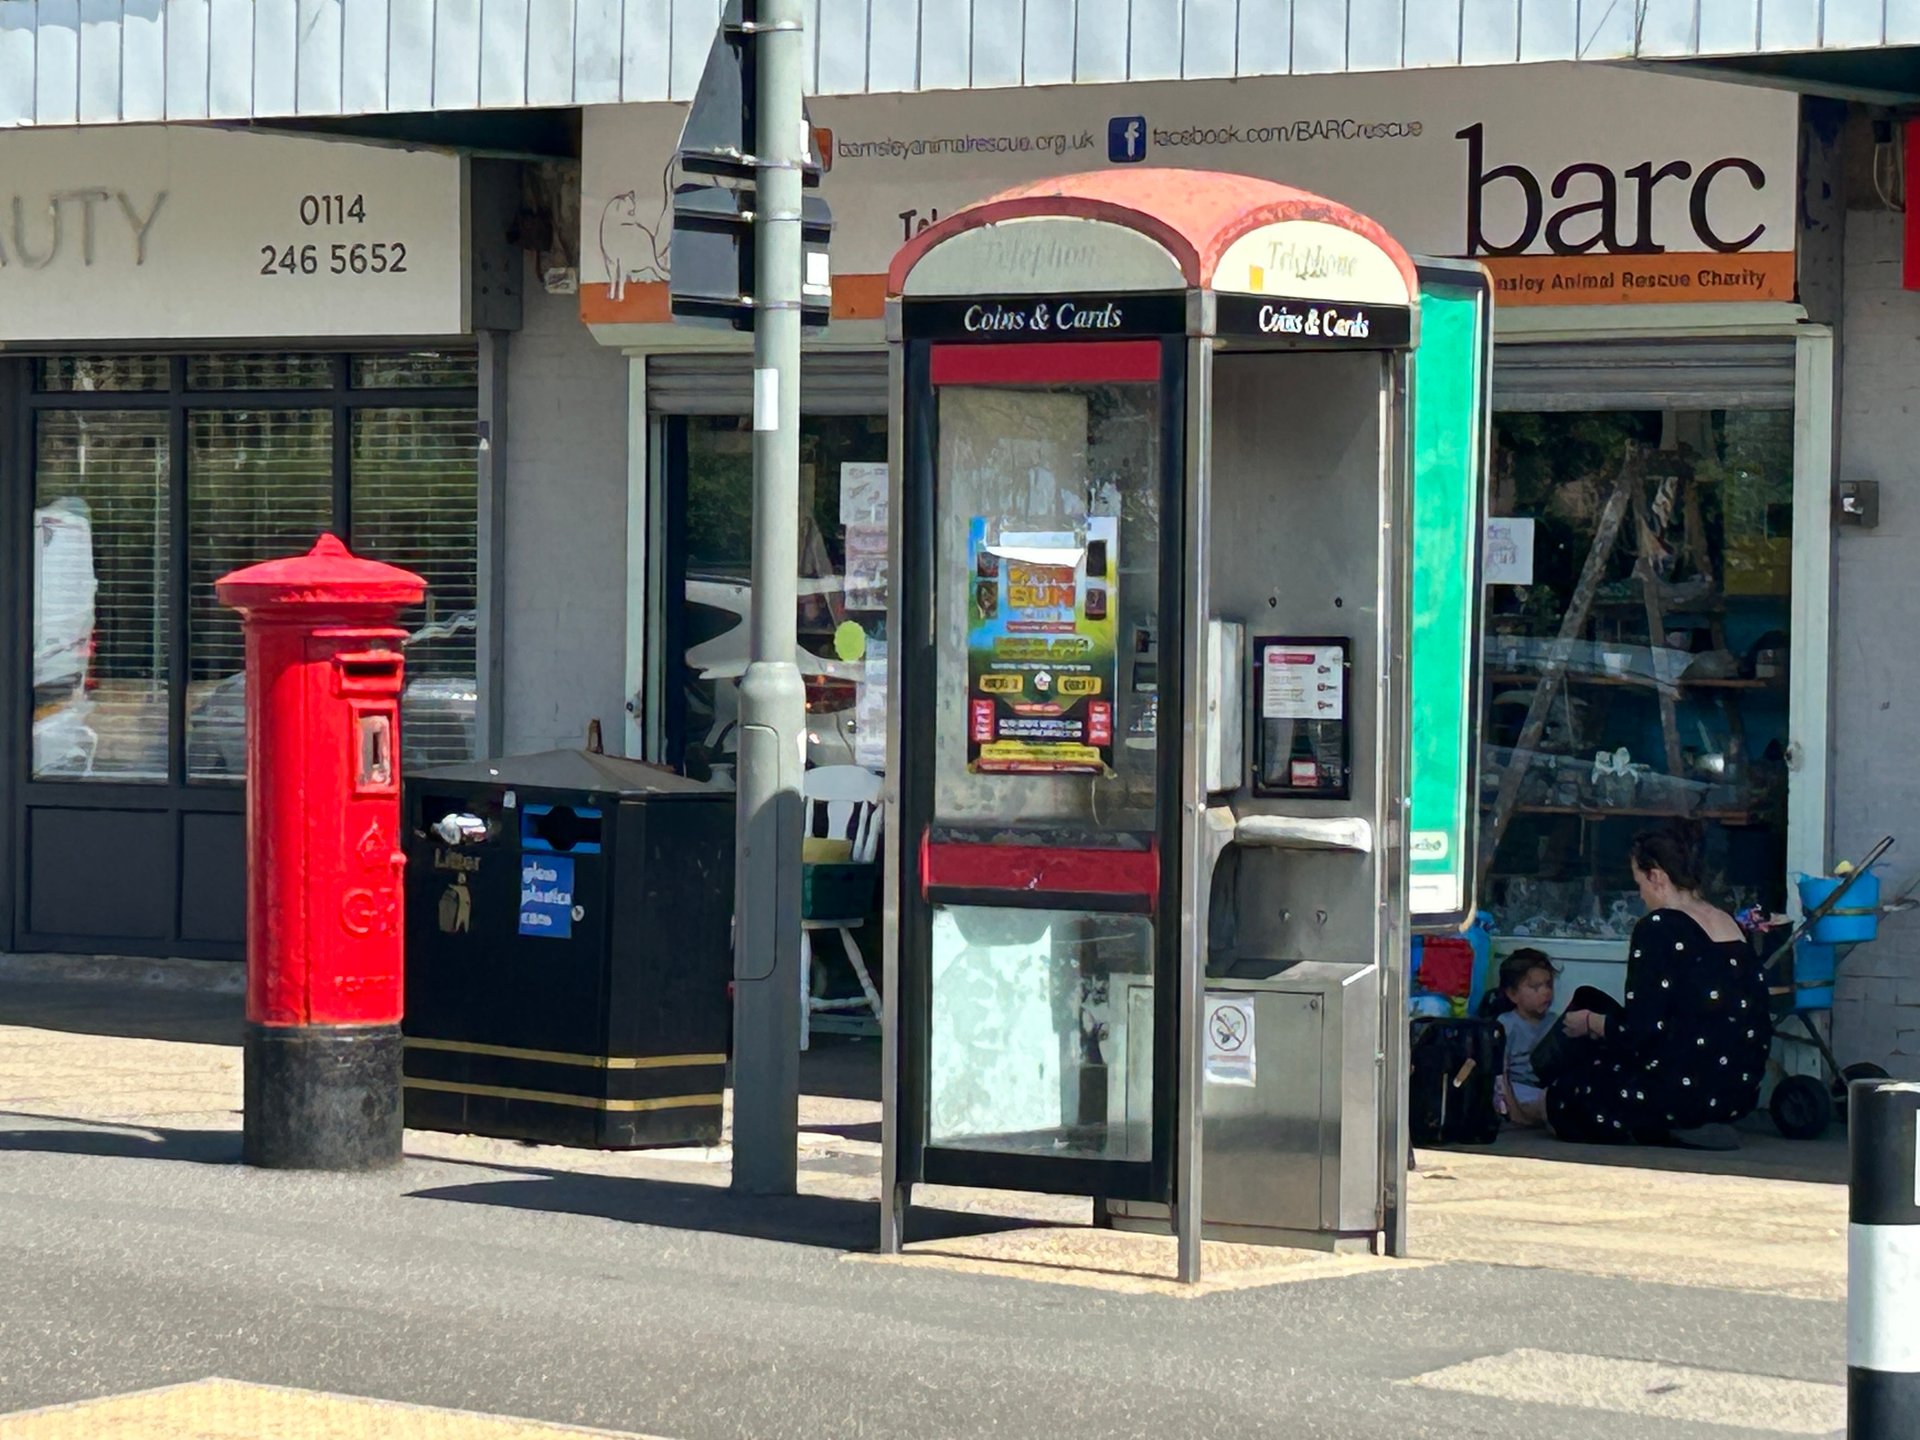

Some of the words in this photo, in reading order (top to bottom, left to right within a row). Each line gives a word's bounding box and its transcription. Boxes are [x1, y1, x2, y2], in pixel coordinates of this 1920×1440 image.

[1454, 121, 1766, 257] barc
[300, 194, 366, 226] 0114
[0, 188, 169, 270] UTY
[260, 244, 318, 275] 246
[330, 242, 408, 275] 5652
[1551, 272, 1615, 290] Animal
[1622, 271, 1690, 289] Rescue
[1697, 268, 1766, 289] Charity
[964, 303, 1026, 332] Coins
[1029, 303, 1050, 331] &
[1056, 302, 1123, 331] Cards
[1258, 305, 1304, 333] Coins
[1304, 308, 1320, 336] &
[1322, 309, 1369, 338] Cards
